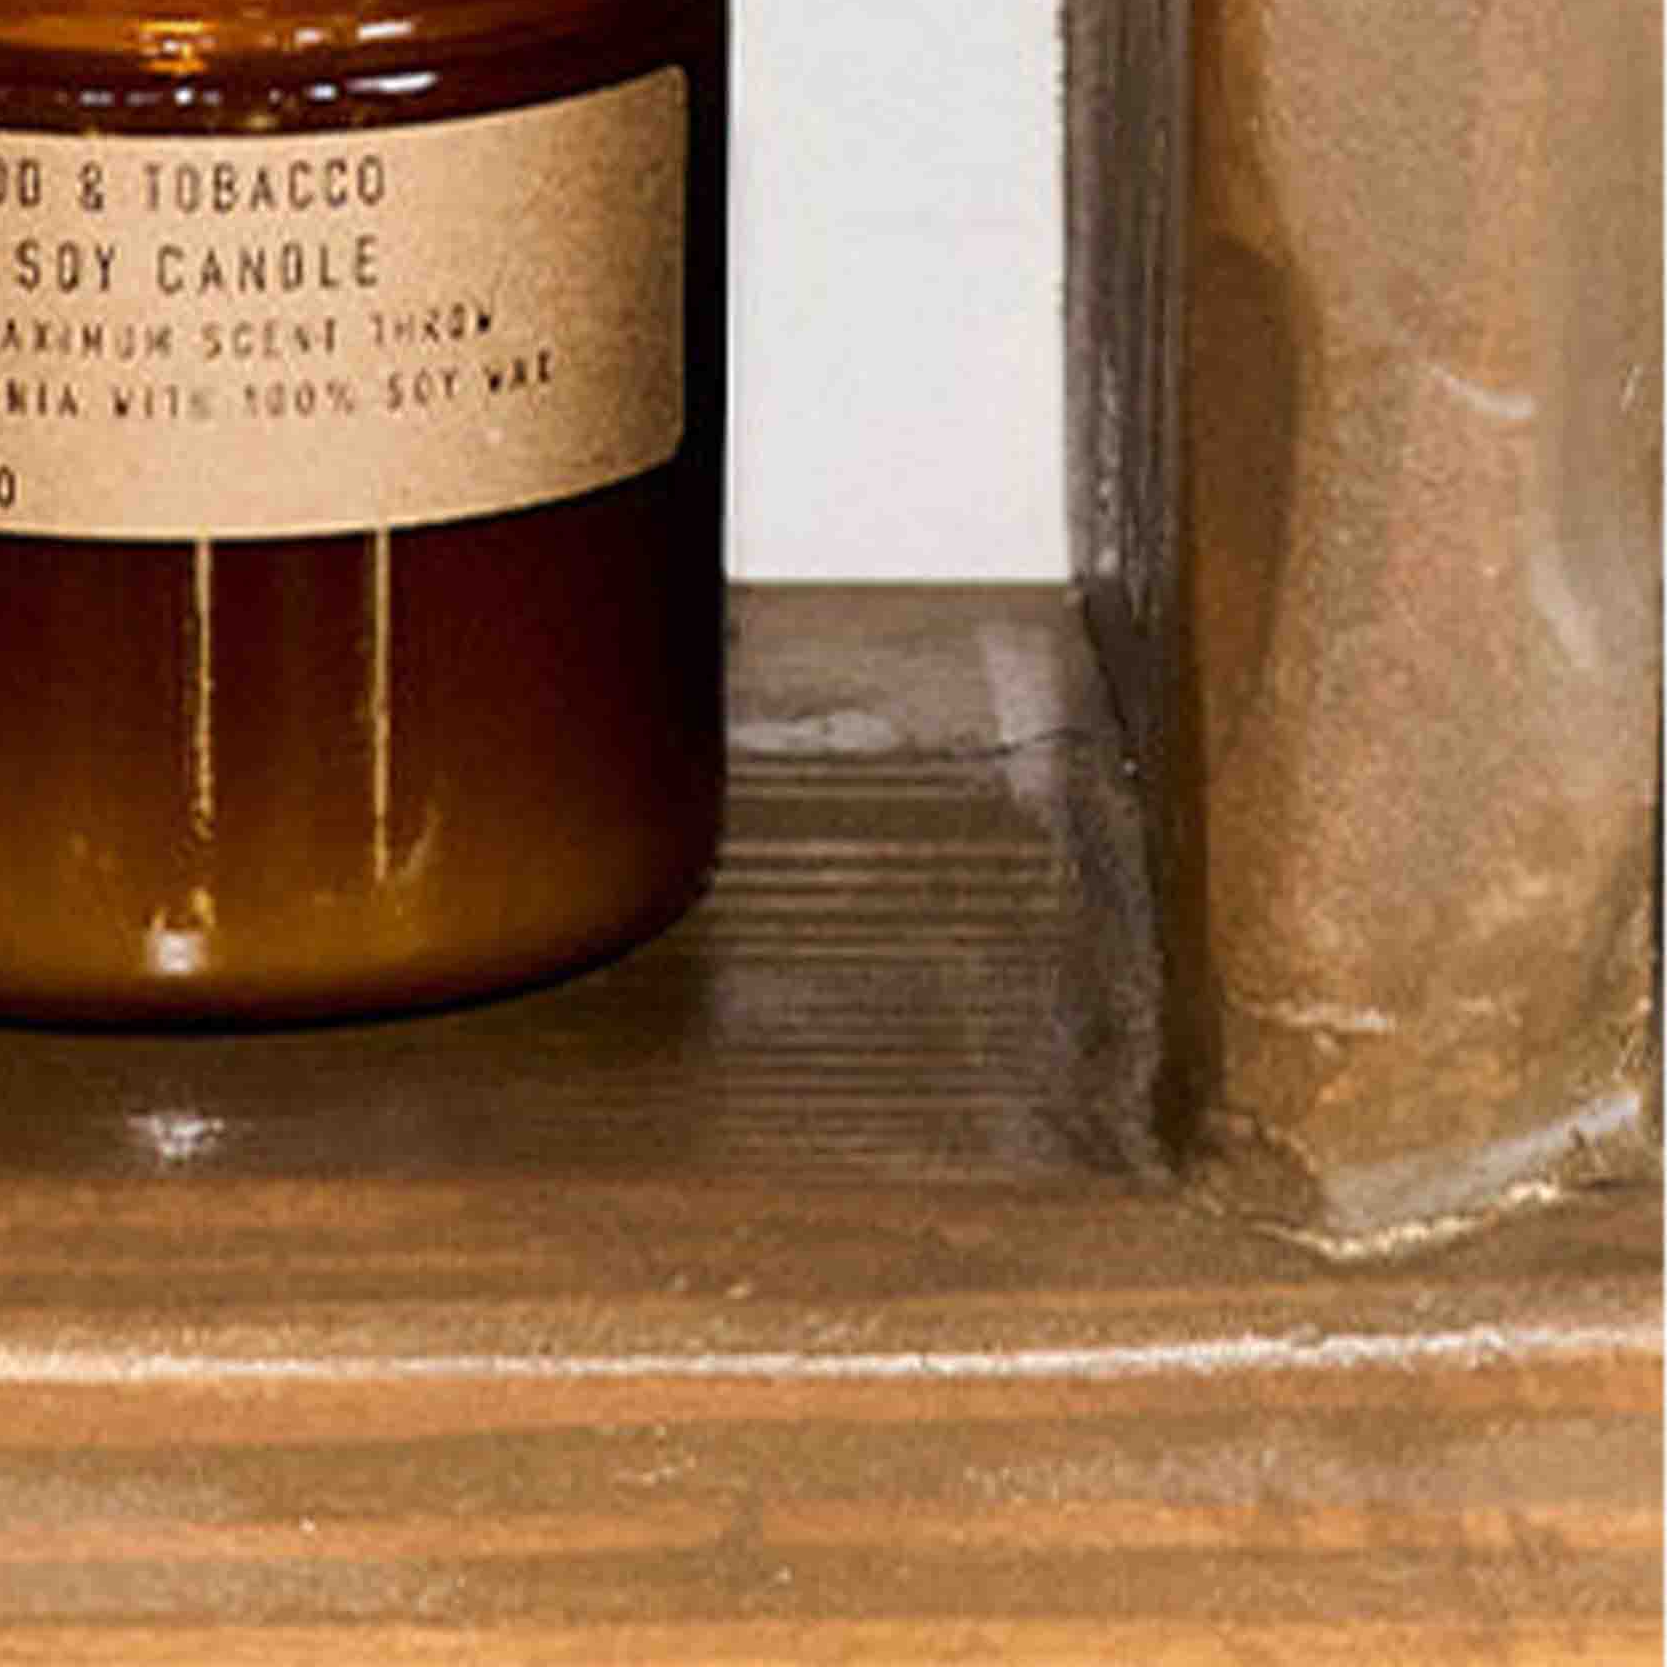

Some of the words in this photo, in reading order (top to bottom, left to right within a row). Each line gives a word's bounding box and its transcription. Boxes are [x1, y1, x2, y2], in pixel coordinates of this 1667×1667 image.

[78, 160, 105, 213] &
[143, 154, 385, 214] TOBACCO
[13, 236, 117, 294] SOY
[156, 235, 379, 295] CANDLE
[200, 315, 338, 361] SCENT
[384, 367, 461, 411] SOY
